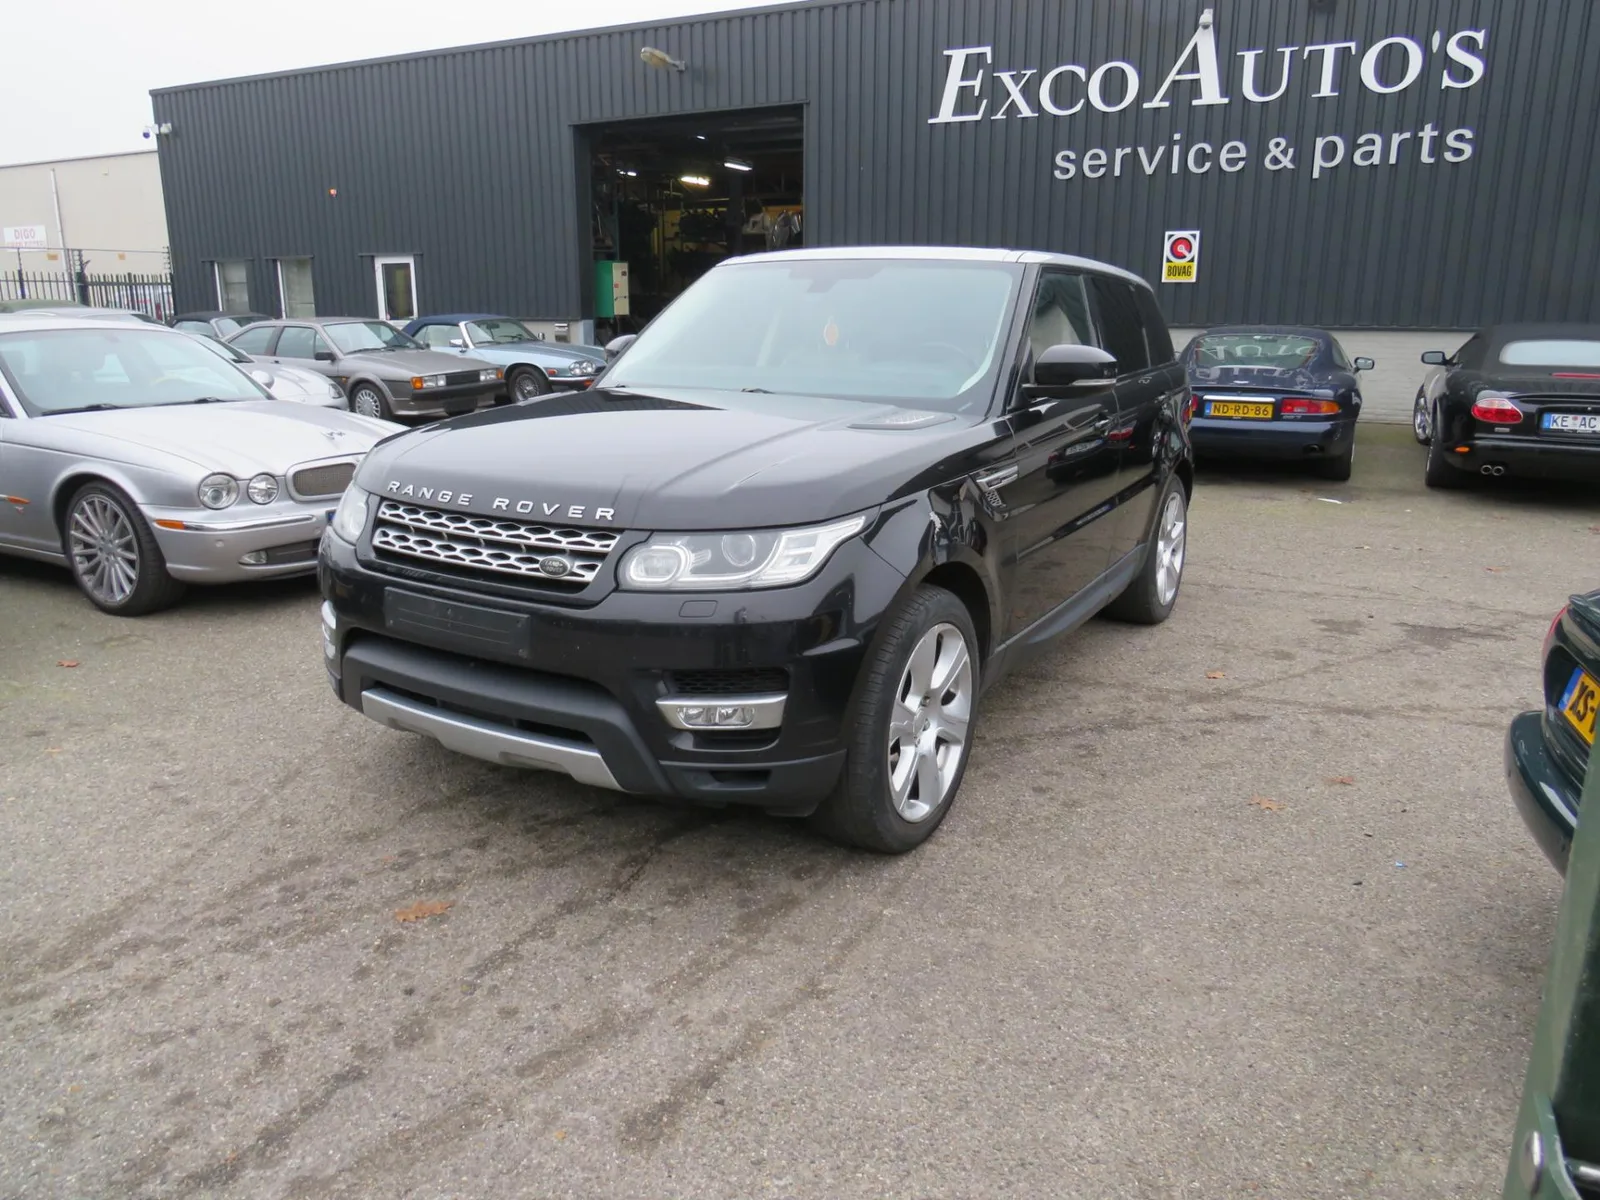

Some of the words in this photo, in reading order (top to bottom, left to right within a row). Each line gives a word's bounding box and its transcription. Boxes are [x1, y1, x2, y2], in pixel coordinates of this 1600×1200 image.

[1054, 132, 1247, 180] service
[1263, 137, 1296, 172] &
[1312, 121, 1475, 179] parts
[1166, 265, 1192, 277] BOVAG
[1212, 403, 1269, 416] ND-RD-86
[387, 480, 473, 506] RANGE
[492, 497, 615, 521] ROVER
[1568, 680, 1598, 735] XS-
